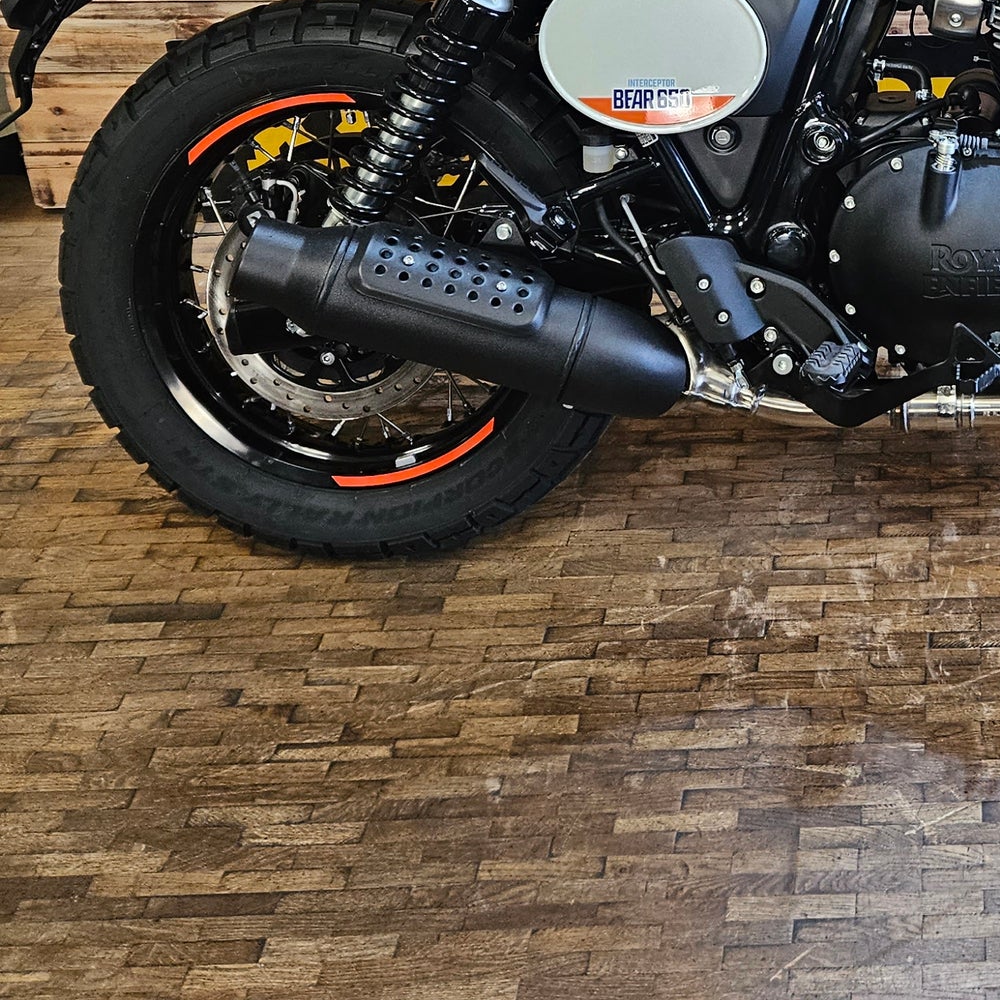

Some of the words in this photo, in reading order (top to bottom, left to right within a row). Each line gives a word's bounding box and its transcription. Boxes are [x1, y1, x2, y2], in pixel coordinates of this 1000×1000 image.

[627, 78, 676, 87] INTERCEPTOR
[613, 88, 654, 110] BEAR
[657, 88, 691, 109] 650
